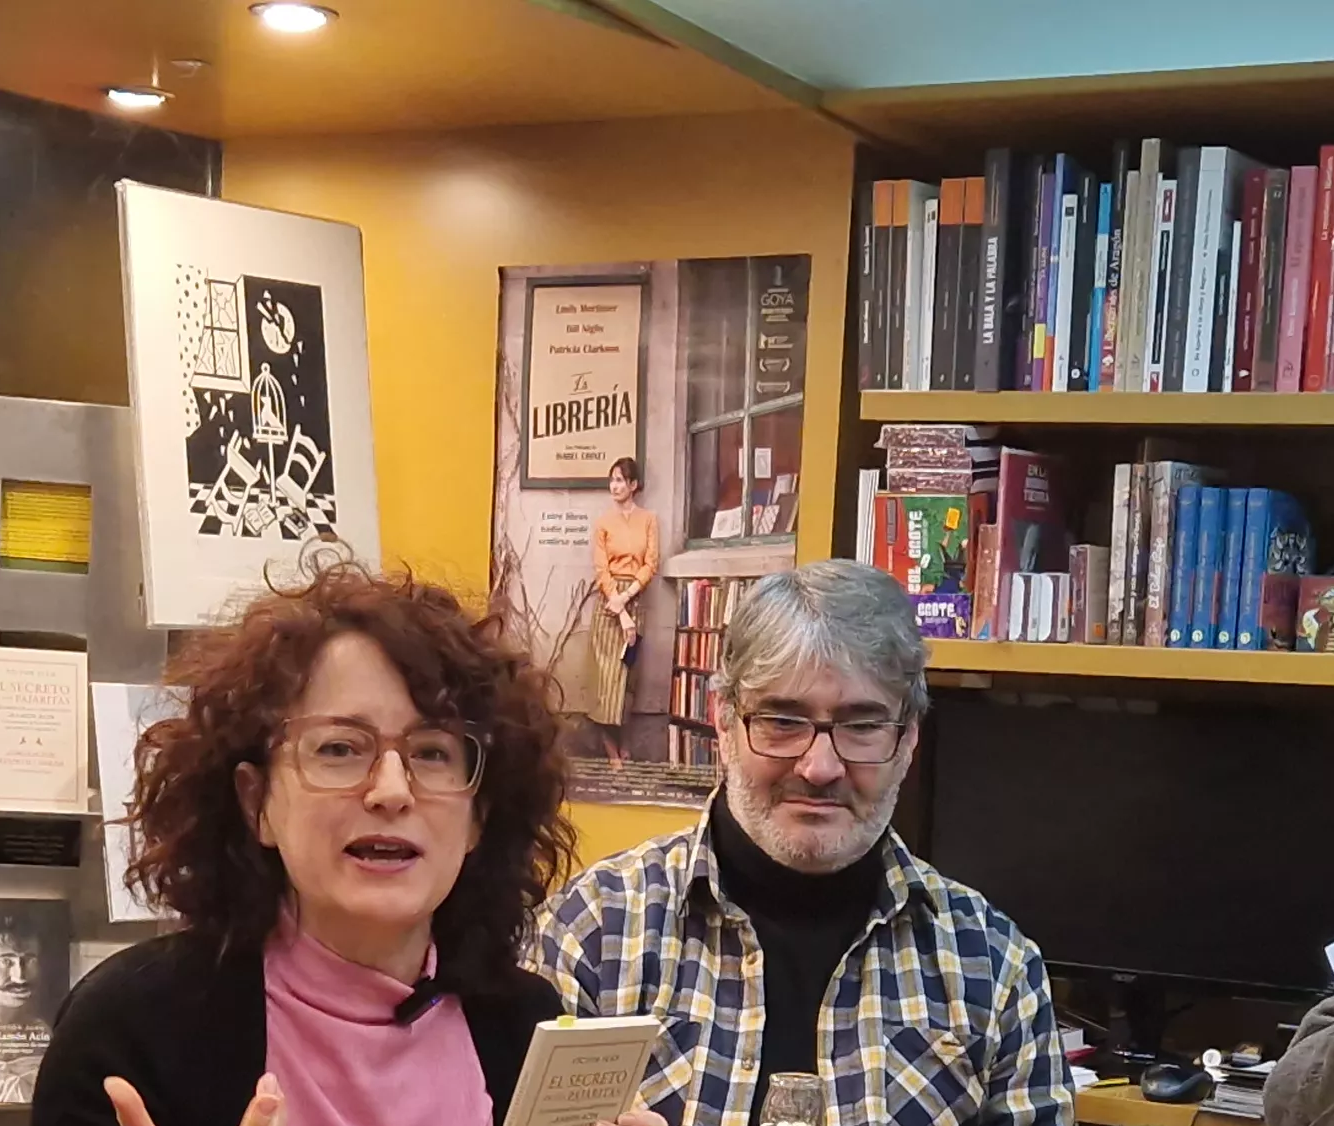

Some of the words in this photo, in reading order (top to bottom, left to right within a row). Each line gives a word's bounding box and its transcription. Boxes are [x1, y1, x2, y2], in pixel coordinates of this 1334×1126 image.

[1110, 228, 1123, 270] Aragón
[986, 236, 999, 279] PALABRA
[1108, 273, 1118, 287] de
[985, 281, 996, 293] LA
[760, 293, 794, 306] GOYA
[580, 304, 619, 313] Mortimer
[982, 305, 995, 329] BALA
[982, 330, 995, 344] LA
[549, 345, 581, 355] Patricia
[583, 345, 620, 354] Clarkson
[532, 383, 632, 439] LIBRERÍA
[10, 682, 70, 695] SECRETO
[15, 694, 70, 705] PAJARITAS
[29, 1032, 50, 1041] Acín
[548, 1075, 562, 1090] EL
[568, 1069, 627, 1088] SECRETO
